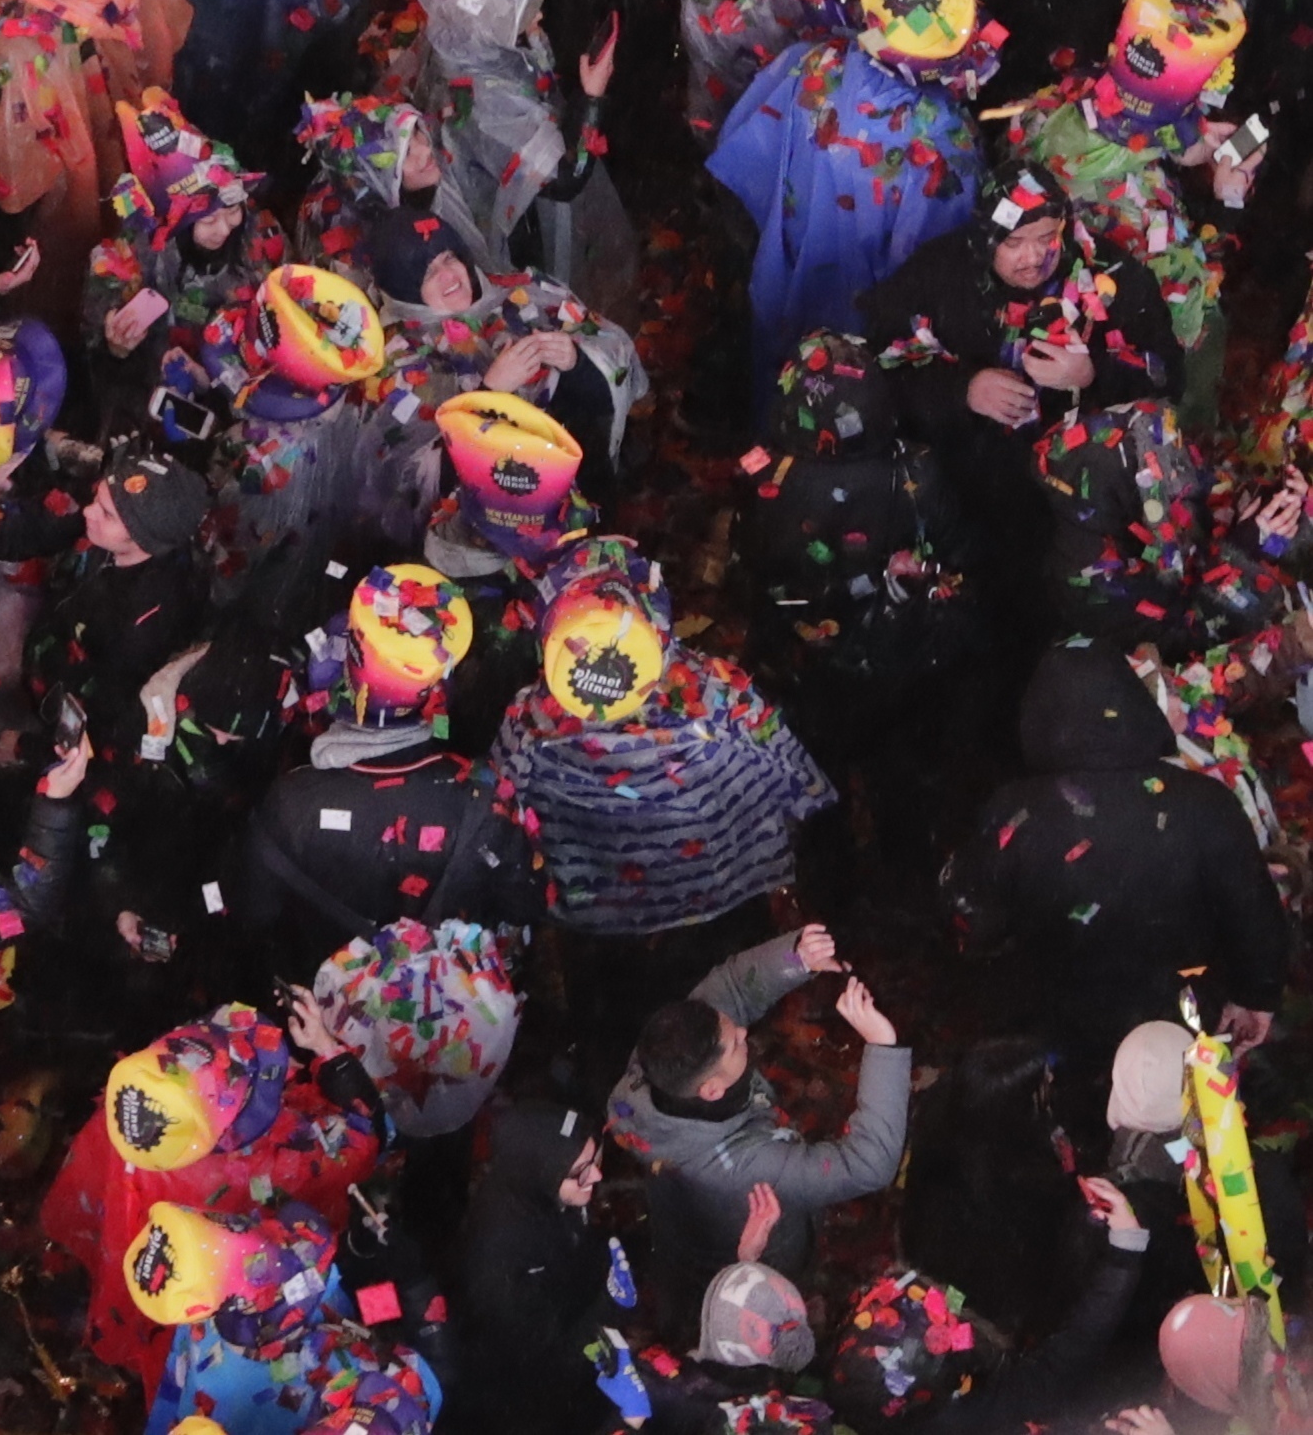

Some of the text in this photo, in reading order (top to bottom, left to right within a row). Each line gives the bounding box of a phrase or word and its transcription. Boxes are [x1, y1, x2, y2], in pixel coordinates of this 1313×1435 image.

[1126, 44, 1155, 68] planet
[493, 472, 529, 483] planet
[498, 479, 536, 490] fitness
[573, 668, 621, 688] planet
[576, 678, 625, 700] fitness
[122, 1094, 134, 1143] fitness
[127, 1089, 140, 1138] planet
[142, 1229, 162, 1280] planet
